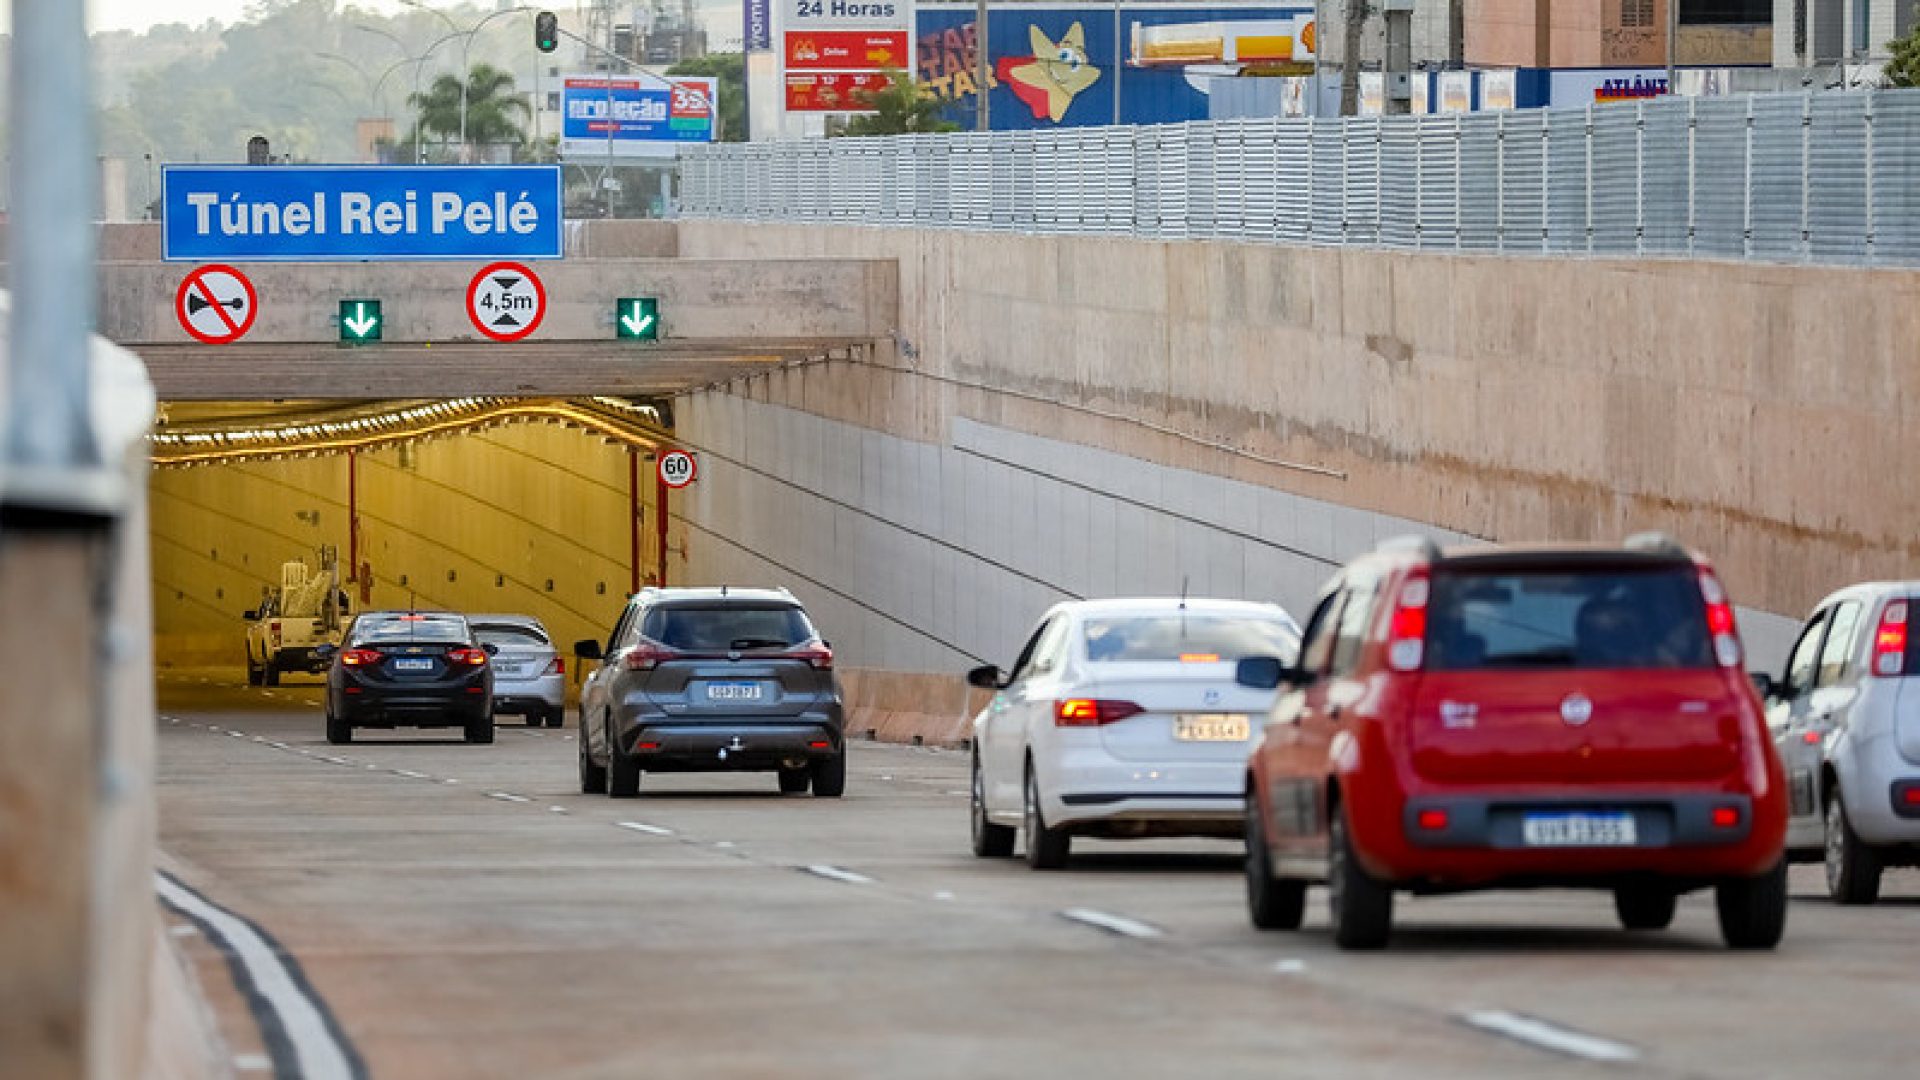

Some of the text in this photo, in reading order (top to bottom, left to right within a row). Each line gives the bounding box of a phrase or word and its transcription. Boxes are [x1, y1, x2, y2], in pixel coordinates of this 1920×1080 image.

[797, 0, 895, 17] 24 Horas
[187, 189, 539, 236] Túnel Rei Pelé
[480, 291, 532, 313] 4,5m
[665, 456, 688, 475] 60
